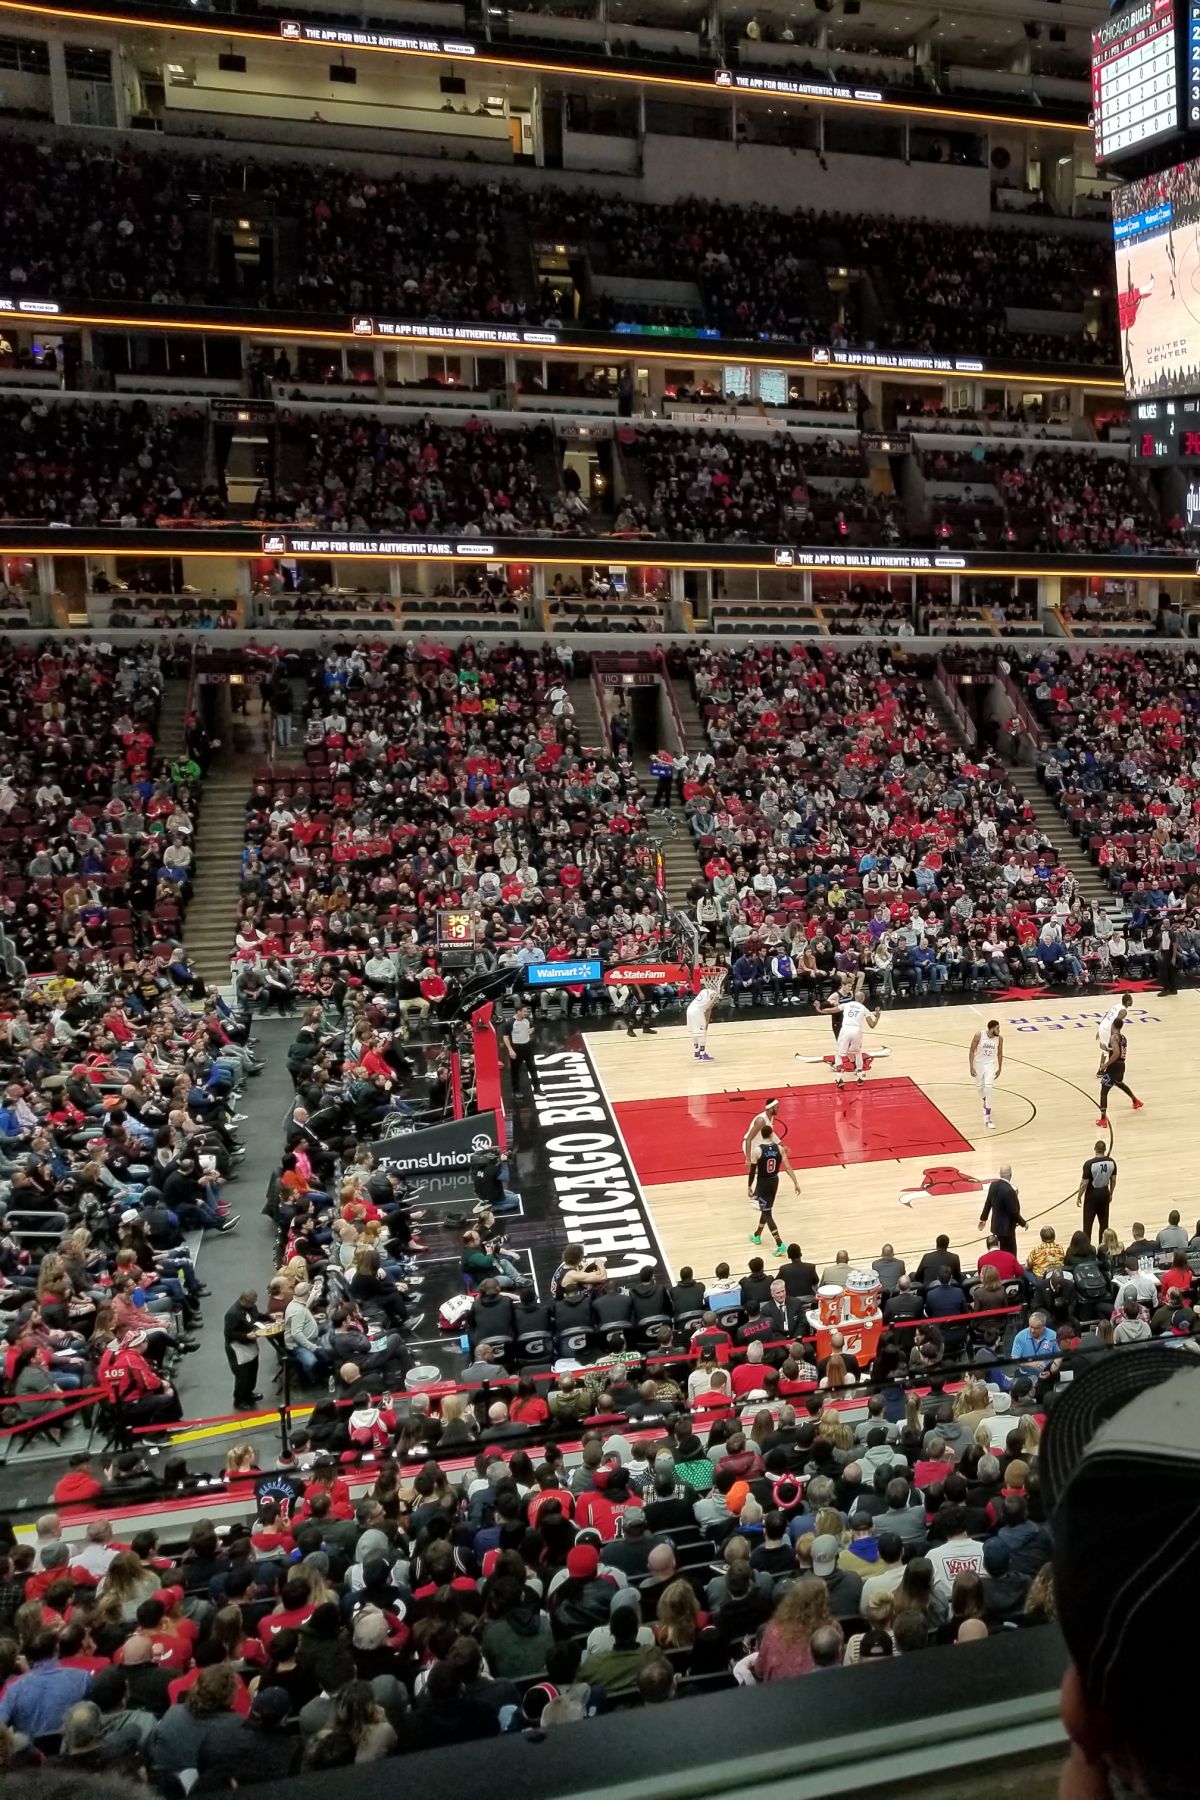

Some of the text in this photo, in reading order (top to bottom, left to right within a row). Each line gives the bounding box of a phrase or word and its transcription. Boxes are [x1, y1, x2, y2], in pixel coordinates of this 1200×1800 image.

[1101, 3, 1151, 44] CHICAGO BULLS
[305, 29, 321, 39] THE
[322, 30, 336, 40] APP
[338, 32, 353, 42] FOR
[354, 33, 377, 45] BULLS
[379, 36, 418, 49] AUTHENTIC
[420, 40, 441, 52] FANS.
[379, 324, 520, 341] THE APP FOR BULLS AUTHENTIC FANS.
[1146, 339, 1187, 354] UNITED
[1147, 348, 1188, 364] CENTER
[292, 541, 453, 554] THE APP FOR BULLS AUTHENTIC FANS.
[537, 969, 577, 978] Walmart
[533, 1051, 606, 1126] BULLS
[767, 1158, 776, 1173] 8
[545, 1132, 657, 1279] CHICAGO
[104, 1369, 125, 1378] 105
